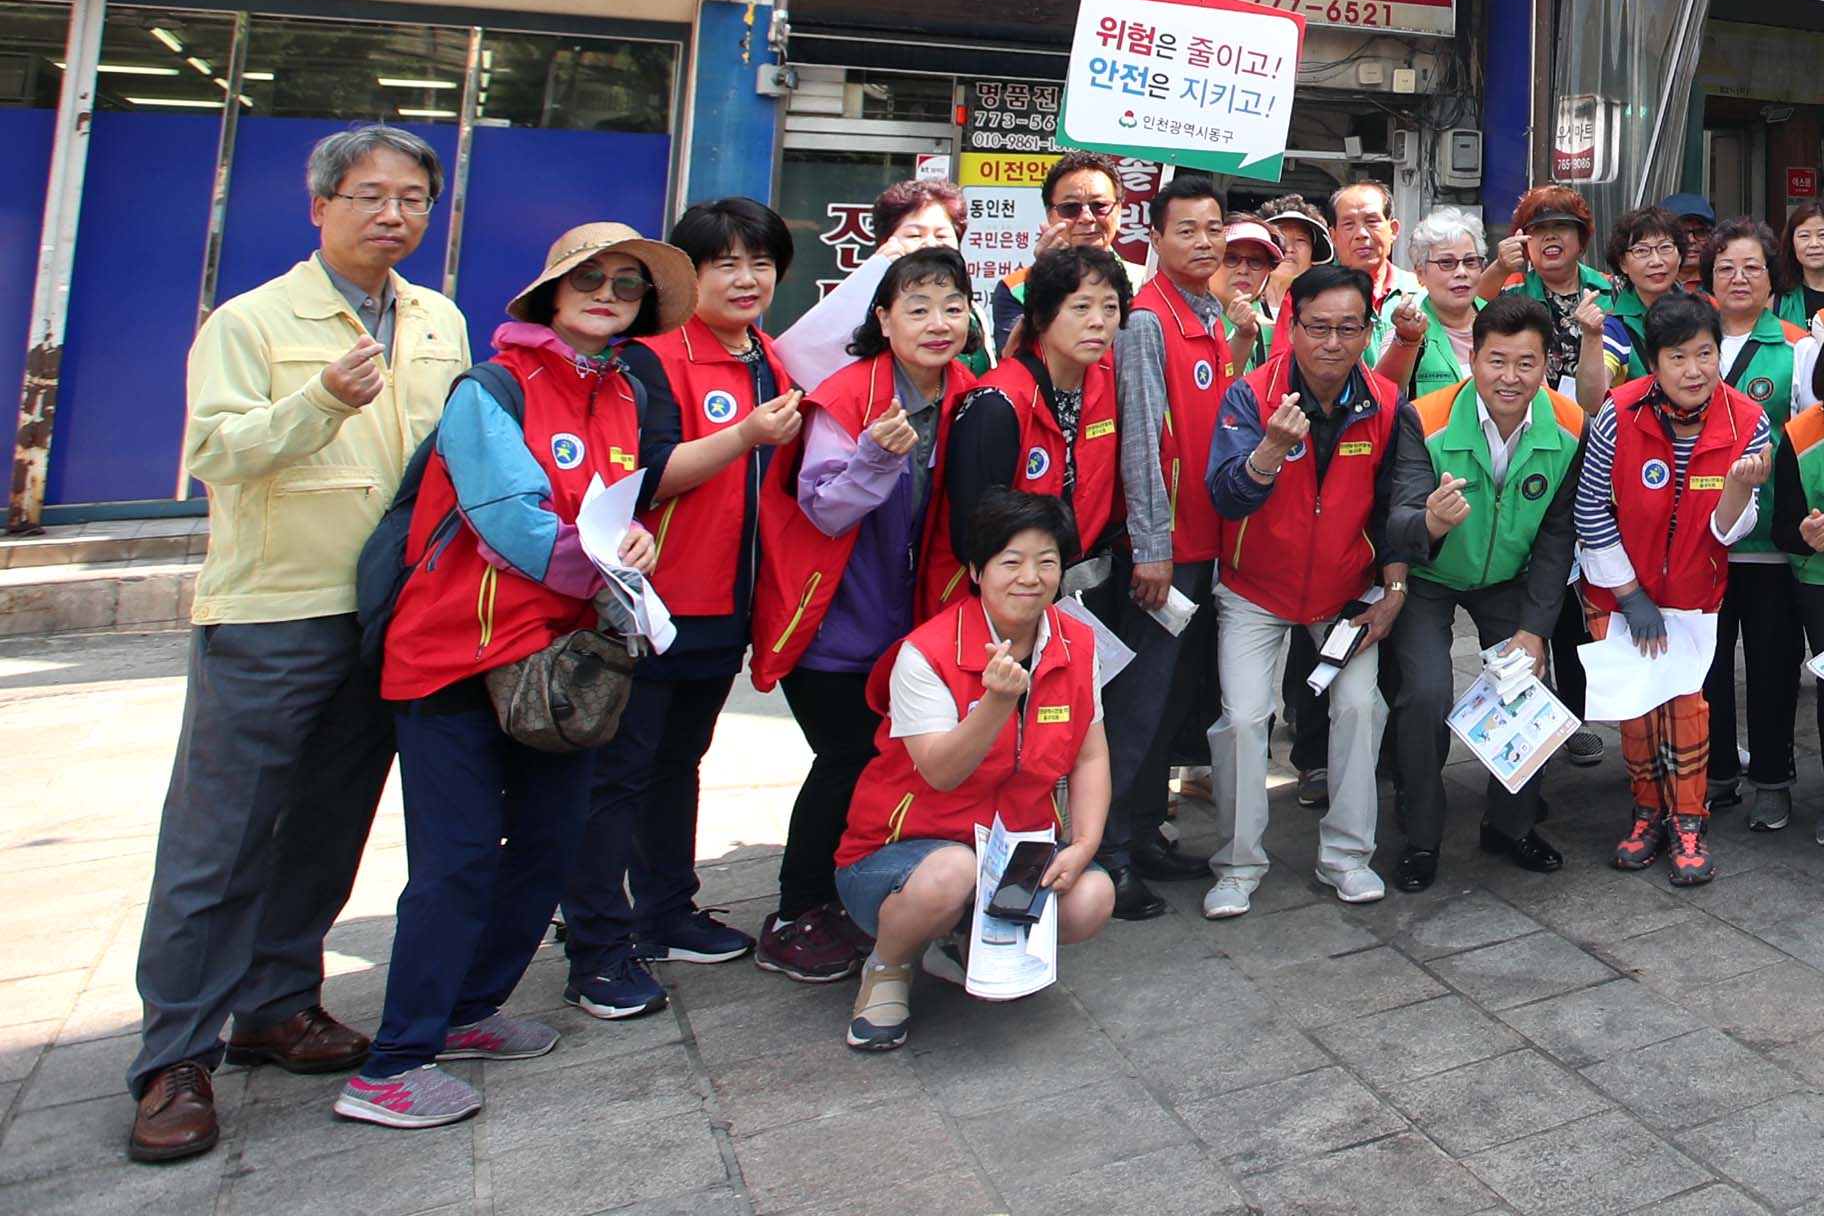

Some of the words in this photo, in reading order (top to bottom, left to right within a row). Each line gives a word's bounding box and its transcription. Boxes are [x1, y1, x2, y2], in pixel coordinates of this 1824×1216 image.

[1096, 16, 1177, 60] 위험은
[1187, 36, 1282, 79] 줄이고!
[1088, 57, 1170, 100] 안전은
[1179, 77, 1276, 119] 지키고!
[974, 111, 1060, 131] 773-56
[1142, 114, 1235, 144] 인천광역시동구
[979, 160, 1053, 183] 이전안
[969, 199, 1016, 218] 동인천
[968, 231, 1029, 249] 국민은행
